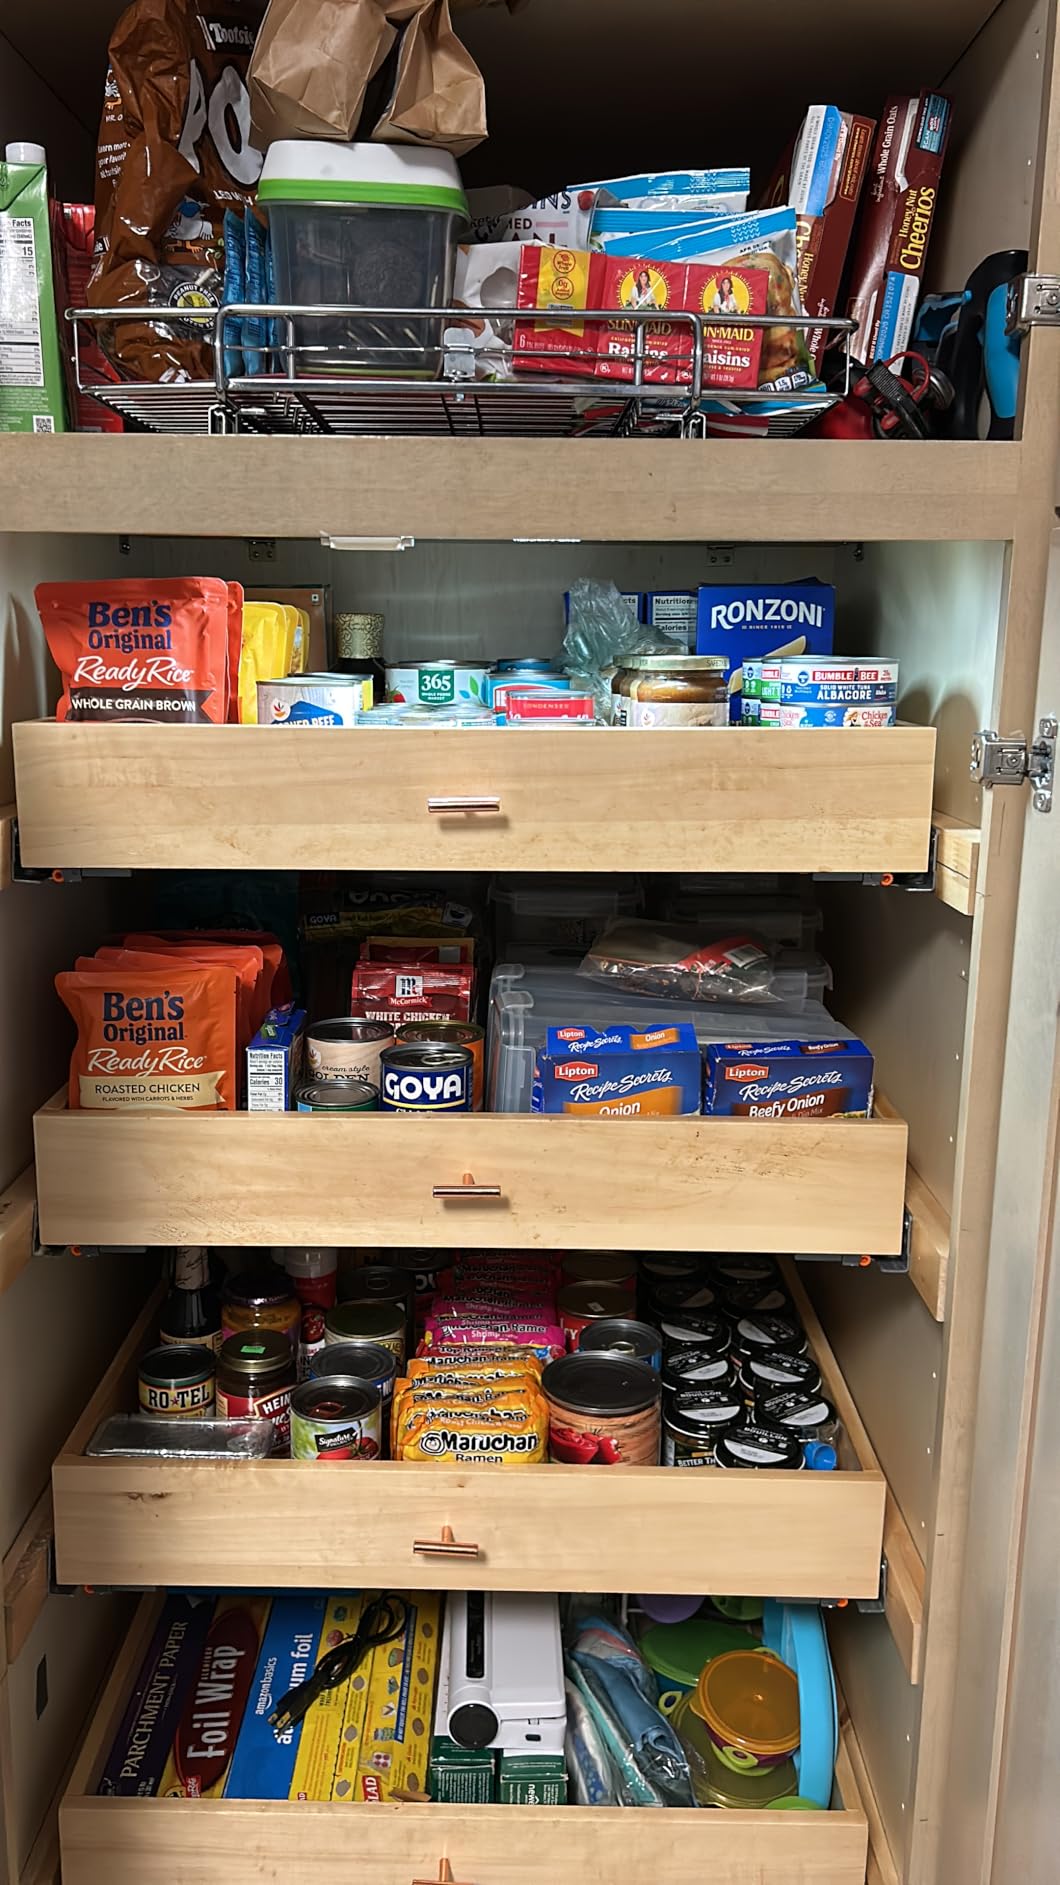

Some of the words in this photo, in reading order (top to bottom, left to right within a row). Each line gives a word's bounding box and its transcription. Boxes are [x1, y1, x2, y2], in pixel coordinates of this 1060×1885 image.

[887, 105, 898, 125] Oats
[882, 125, 894, 149] Grain
[922, 130, 931, 149] SCAN
[877, 149, 890, 175] Whole
[905, 189, 918, 207] Nut
[12, 219, 32, 227] Facts
[509, 218, 533, 230] ED
[898, 208, 914, 238] Honey
[900, 186, 938, 271] Cheerios
[22, 246, 33, 256] 15
[173, 285, 199, 301] PEANUT
[519, 334, 526, 348] 6
[608, 341, 669, 360] Raiins
[702, 349, 750, 368] aisins
[87, 600, 173, 628] Ben's
[711, 598, 824, 630] RONZONI
[657, 624, 688, 632] Calories
[87, 629, 173, 653] Original
[73, 656, 147, 692] Ready
[146, 656, 192, 685] Rice
[421, 673, 452, 692] 365
[813, 671, 853, 682] BUMBLE
[860, 671, 877, 681] BEE
[71, 697, 113, 710] WHOLE
[115, 698, 154, 711] GRAIN
[156, 699, 196, 712] BROWN
[816, 690, 872, 700] ALBACORE
[861, 711, 888, 721] Chicken
[102, 990, 185, 1022] Ben's
[390, 996, 428, 1005] McCormick
[365, 1011, 401, 1022] WHITE
[403, 1011, 451, 1022] CHICKEN
[102, 1022, 185, 1046] Original
[558, 1029, 583, 1039] Lipton
[567, 1040, 596, 1053] Recipe
[594, 1034, 622, 1048] Secrets
[645, 1032, 666, 1042] Onion
[87, 1046, 160, 1077] Ready
[152, 1046, 204, 1071] Rice
[348, 1064, 370, 1073] style
[558, 1063, 596, 1078] Lipton
[274, 1076, 283, 1085] 30
[727, 1066, 767, 1080] Lipton
[95, 1084, 146, 1094] ROASTED
[148, 1082, 201, 1093] CHICKEN
[385, 1072, 462, 1101] GOYA
[569, 1080, 619, 1102] Recipe
[613, 1068, 674, 1090] Secrets
[738, 1081, 789, 1102] Recipe
[783, 1070, 844, 1092] Secrets
[599, 1101, 641, 1115] Onion
[749, 1100, 786, 1117] Beefy
[787, 1093, 826, 1112] Onion
[471, 1330, 501, 1338] Shrimp
[427, 1355, 487, 1365] Maruchan
[147, 1388, 169, 1409] RO
[175, 1383, 211, 1408] TEL
[319, 1433, 351, 1448] Signature
[441, 1430, 539, 1451] Maruchan
[455, 1453, 504, 1464] Ramen
[677, 1458, 704, 1467] BETTER
[291, 1633, 314, 1658] foil
[195, 1645, 246, 1707] Wrap
[255, 1656, 277, 1716] amazonbasics
[120, 1671, 172, 1781] PARCHMENT
[158, 1617, 189, 1670] PAPER
[187, 1710, 233, 1760] Foil
